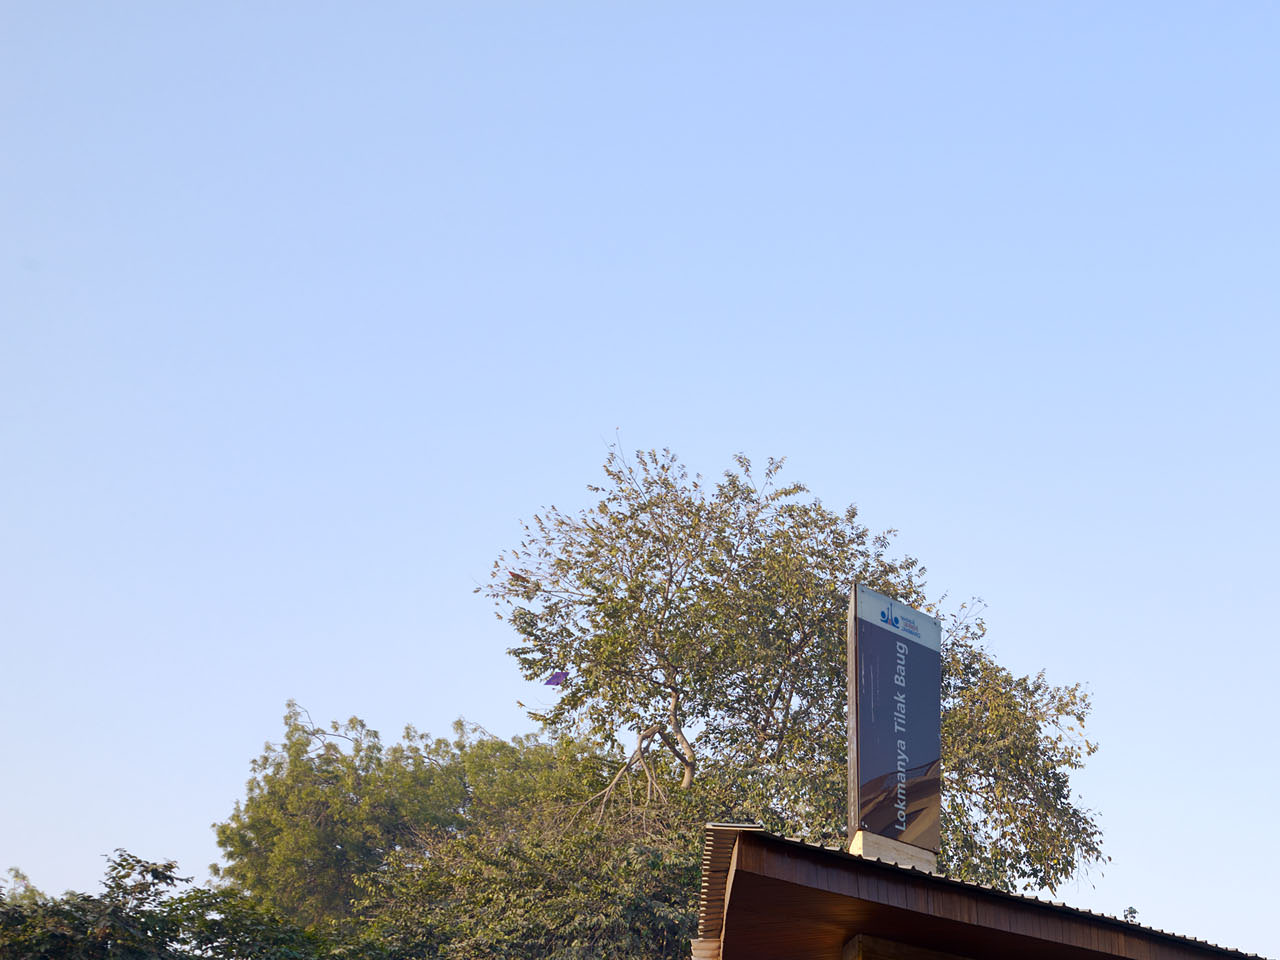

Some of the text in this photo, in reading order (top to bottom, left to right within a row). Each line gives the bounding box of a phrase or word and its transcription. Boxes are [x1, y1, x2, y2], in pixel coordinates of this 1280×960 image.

[894, 641, 909, 832] Lokmanya Tilak Baug
